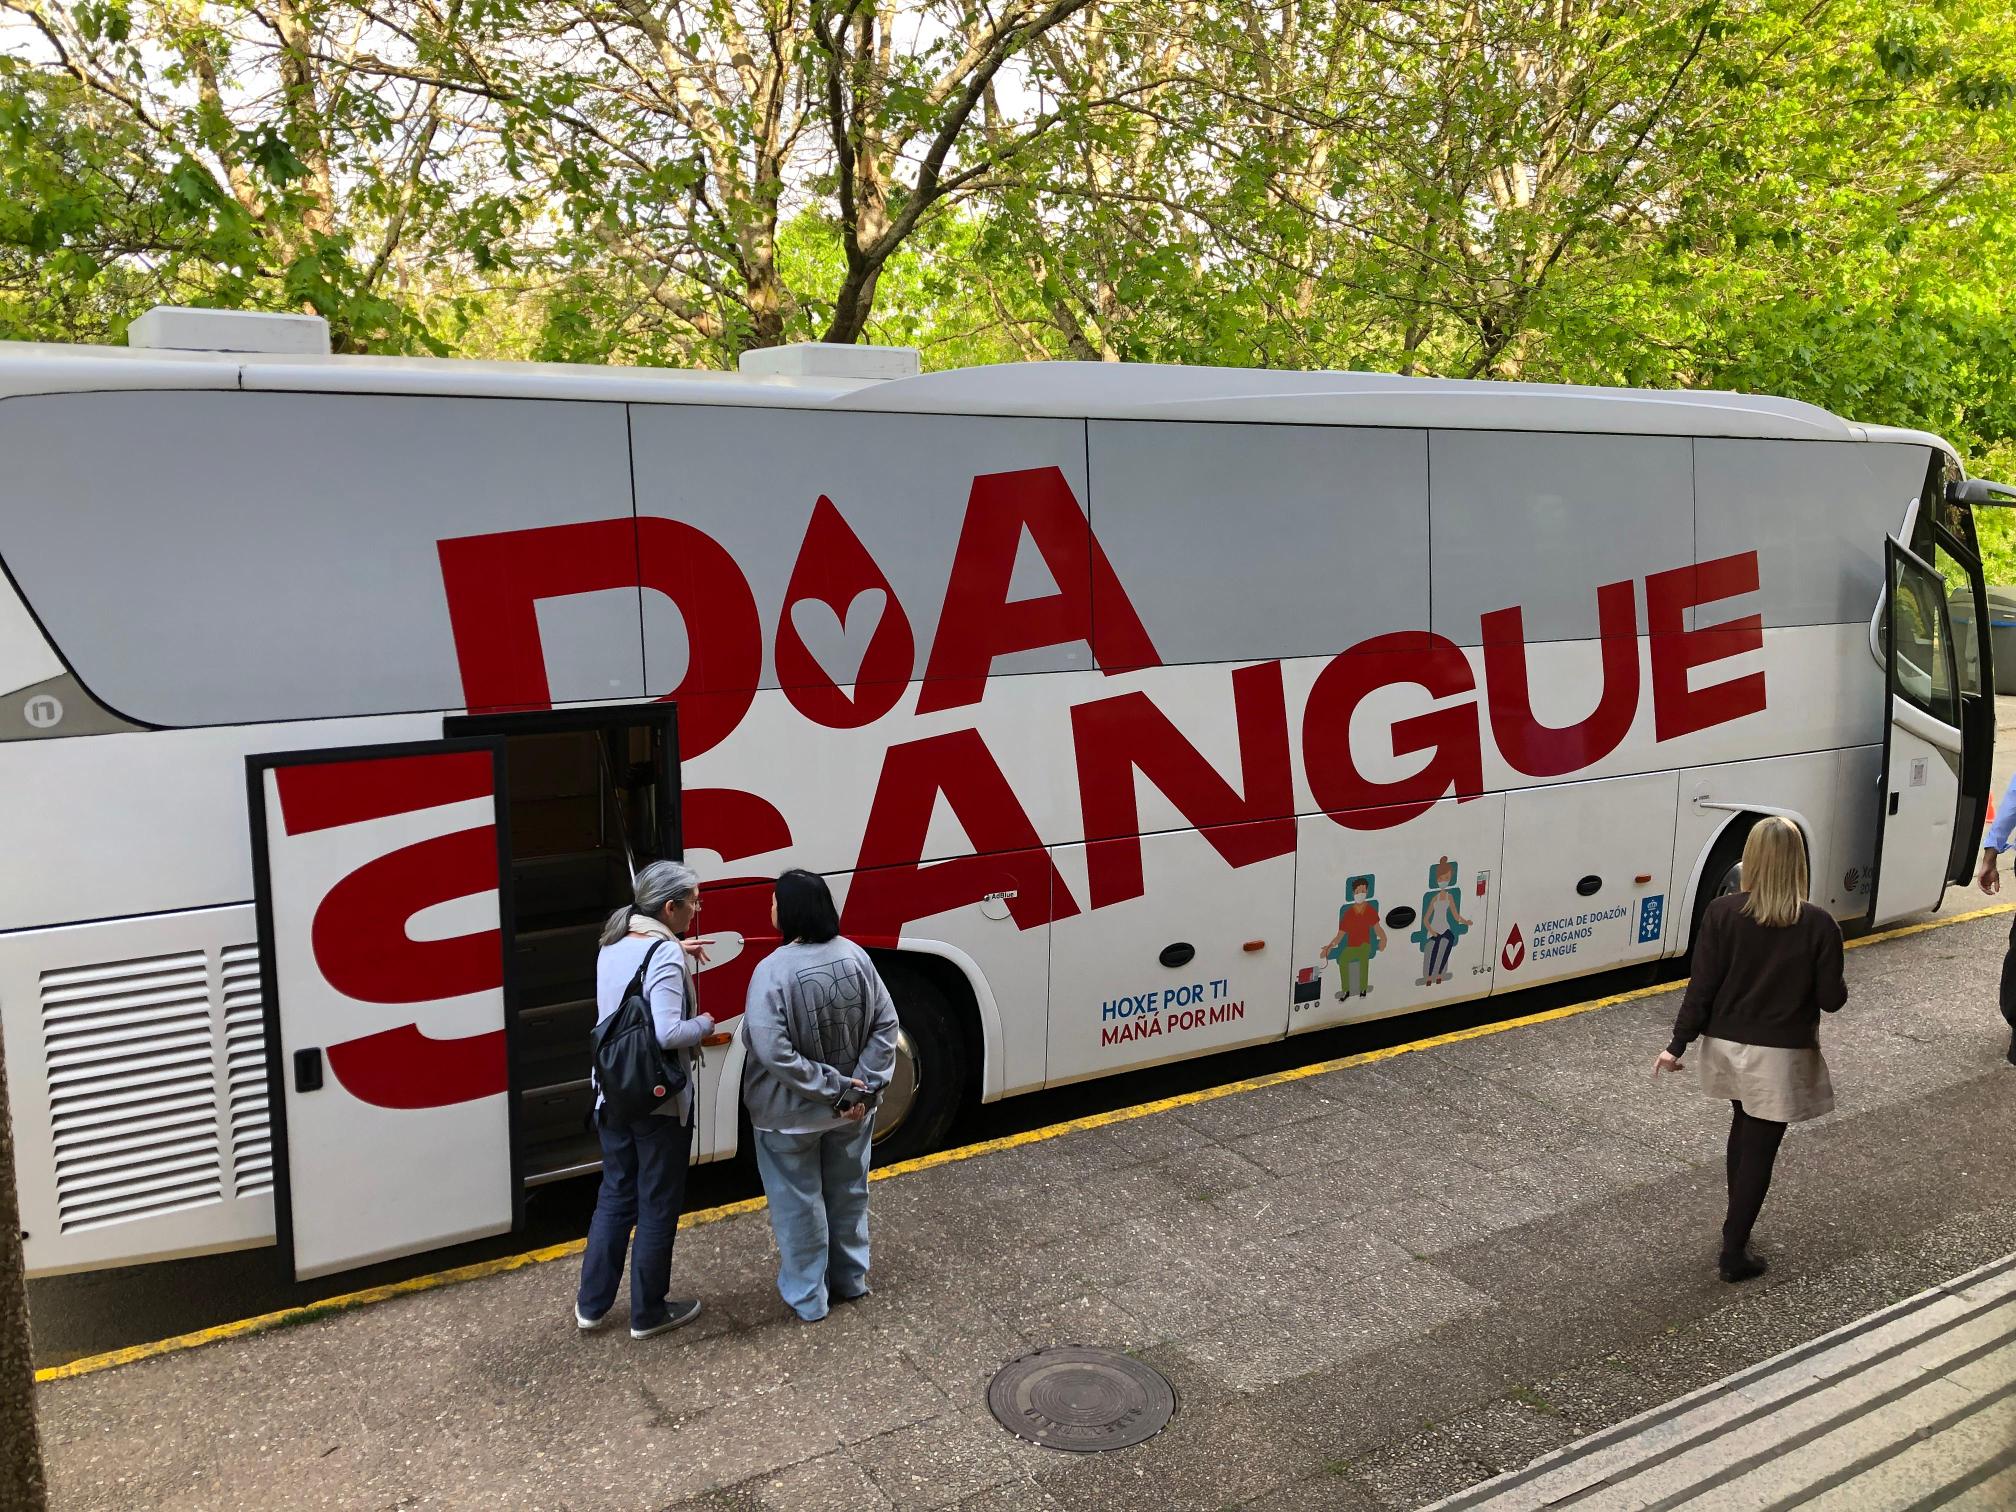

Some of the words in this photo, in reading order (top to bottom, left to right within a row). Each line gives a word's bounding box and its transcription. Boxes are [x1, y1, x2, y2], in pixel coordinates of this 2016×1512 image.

[991, 891, 1014, 900] AdBlue
[1534, 917, 1574, 934] AXENCIA
[1576, 914, 1588, 926] DE
[1590, 905, 1627, 923] DOAZÓN
[1533, 936, 1546, 948] DE
[1547, 927, 1592, 945] ÓRGANOS
[1532, 950, 1538, 961] E
[1539, 943, 1577, 960] SANGUE
[1102, 992, 1158, 1021] HOXE
[1163, 984, 1204, 1010] POR
[1209, 979, 1227, 999] TI
[1101, 1011, 1162, 1047] MAÑÁ
[1167, 1009, 1206, 1033] POR
[1209, 1001, 1245, 1025] MIN
